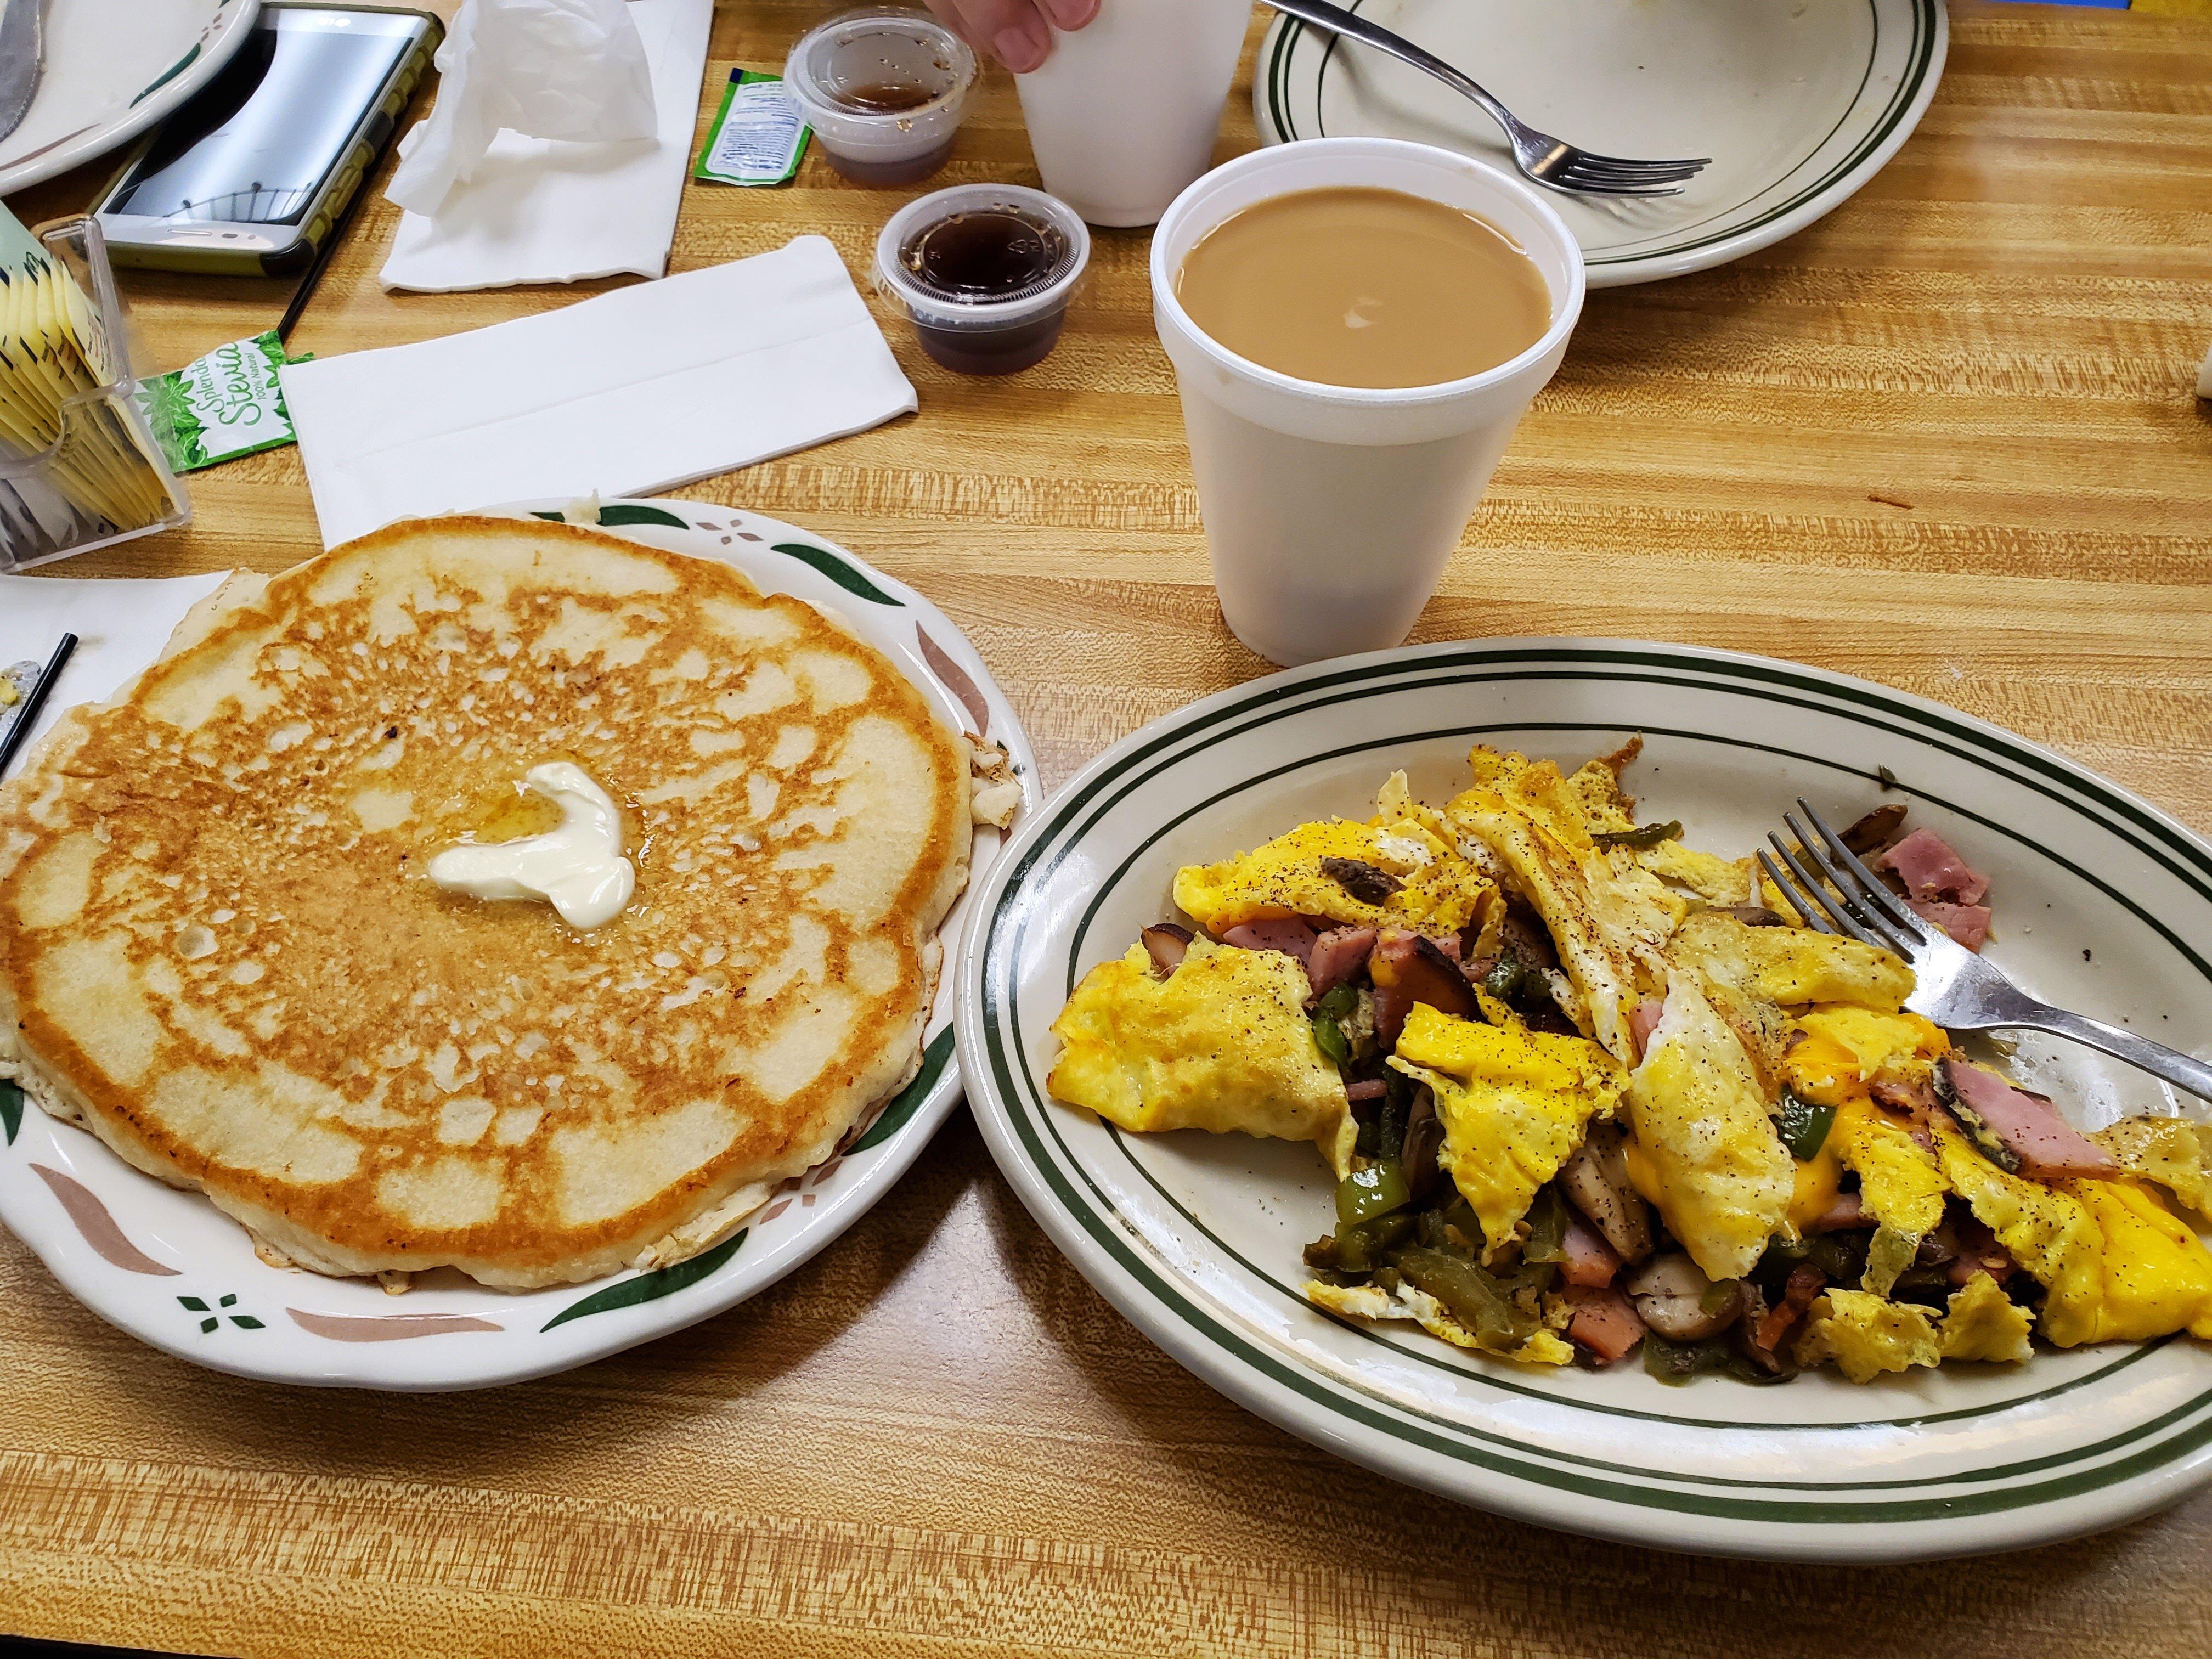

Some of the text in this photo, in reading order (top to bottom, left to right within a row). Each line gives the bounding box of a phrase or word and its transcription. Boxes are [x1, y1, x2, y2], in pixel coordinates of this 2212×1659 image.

[191, 358, 224, 412] Splenda
[216, 343, 261, 425] Stevia
[244, 353, 267, 400] 100% Natural
